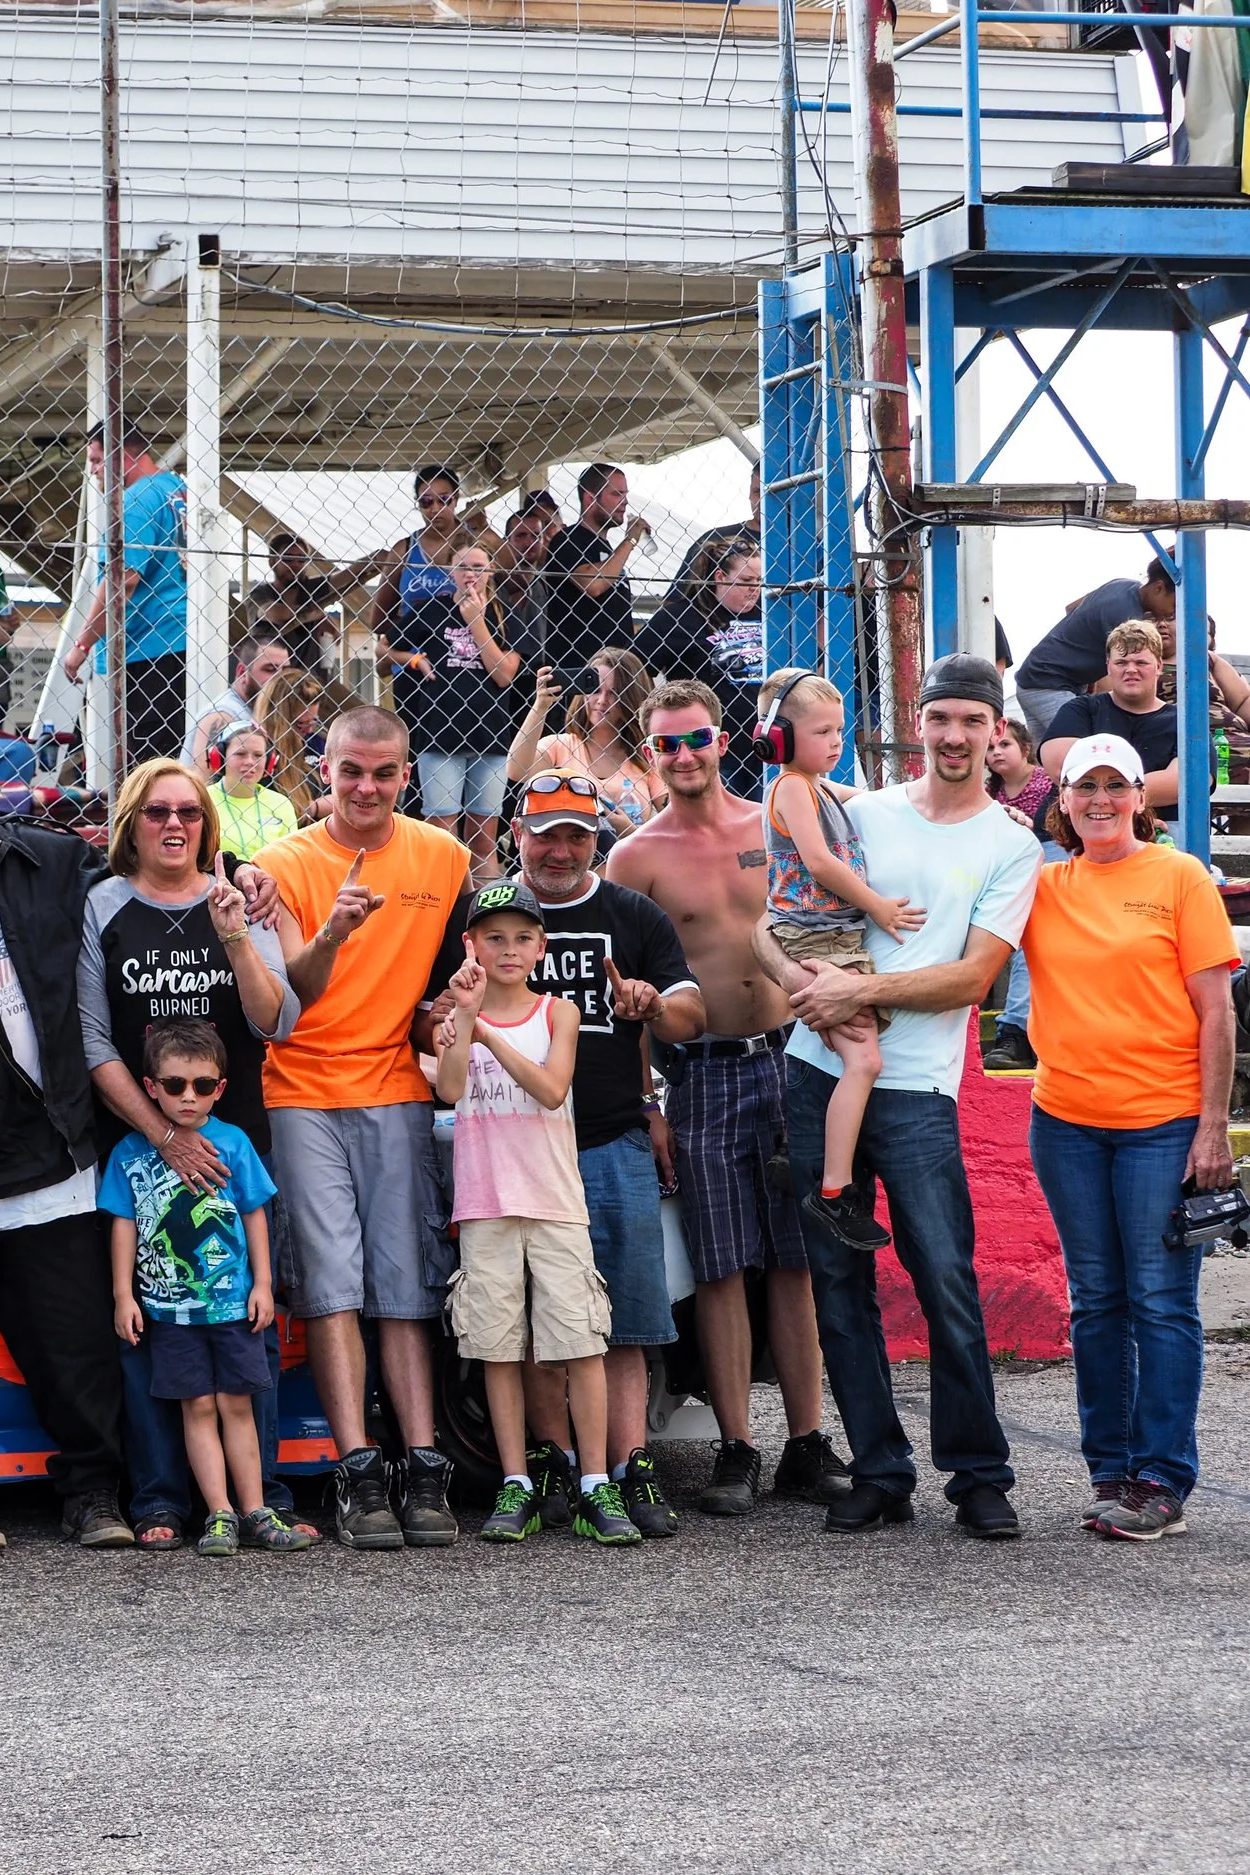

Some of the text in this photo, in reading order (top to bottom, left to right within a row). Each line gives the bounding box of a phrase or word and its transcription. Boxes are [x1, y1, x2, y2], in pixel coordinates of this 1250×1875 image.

[477, 886, 517, 907] FOX
[146, 947, 210, 967] IF ONLY
[121, 957, 234, 995] Sarcasm
[6, 1002, 28, 1017] YOR
[150, 996, 210, 1017] BURNED
[468, 1059, 496, 1078] THE
[469, 1082, 528, 1104] AWAIT
